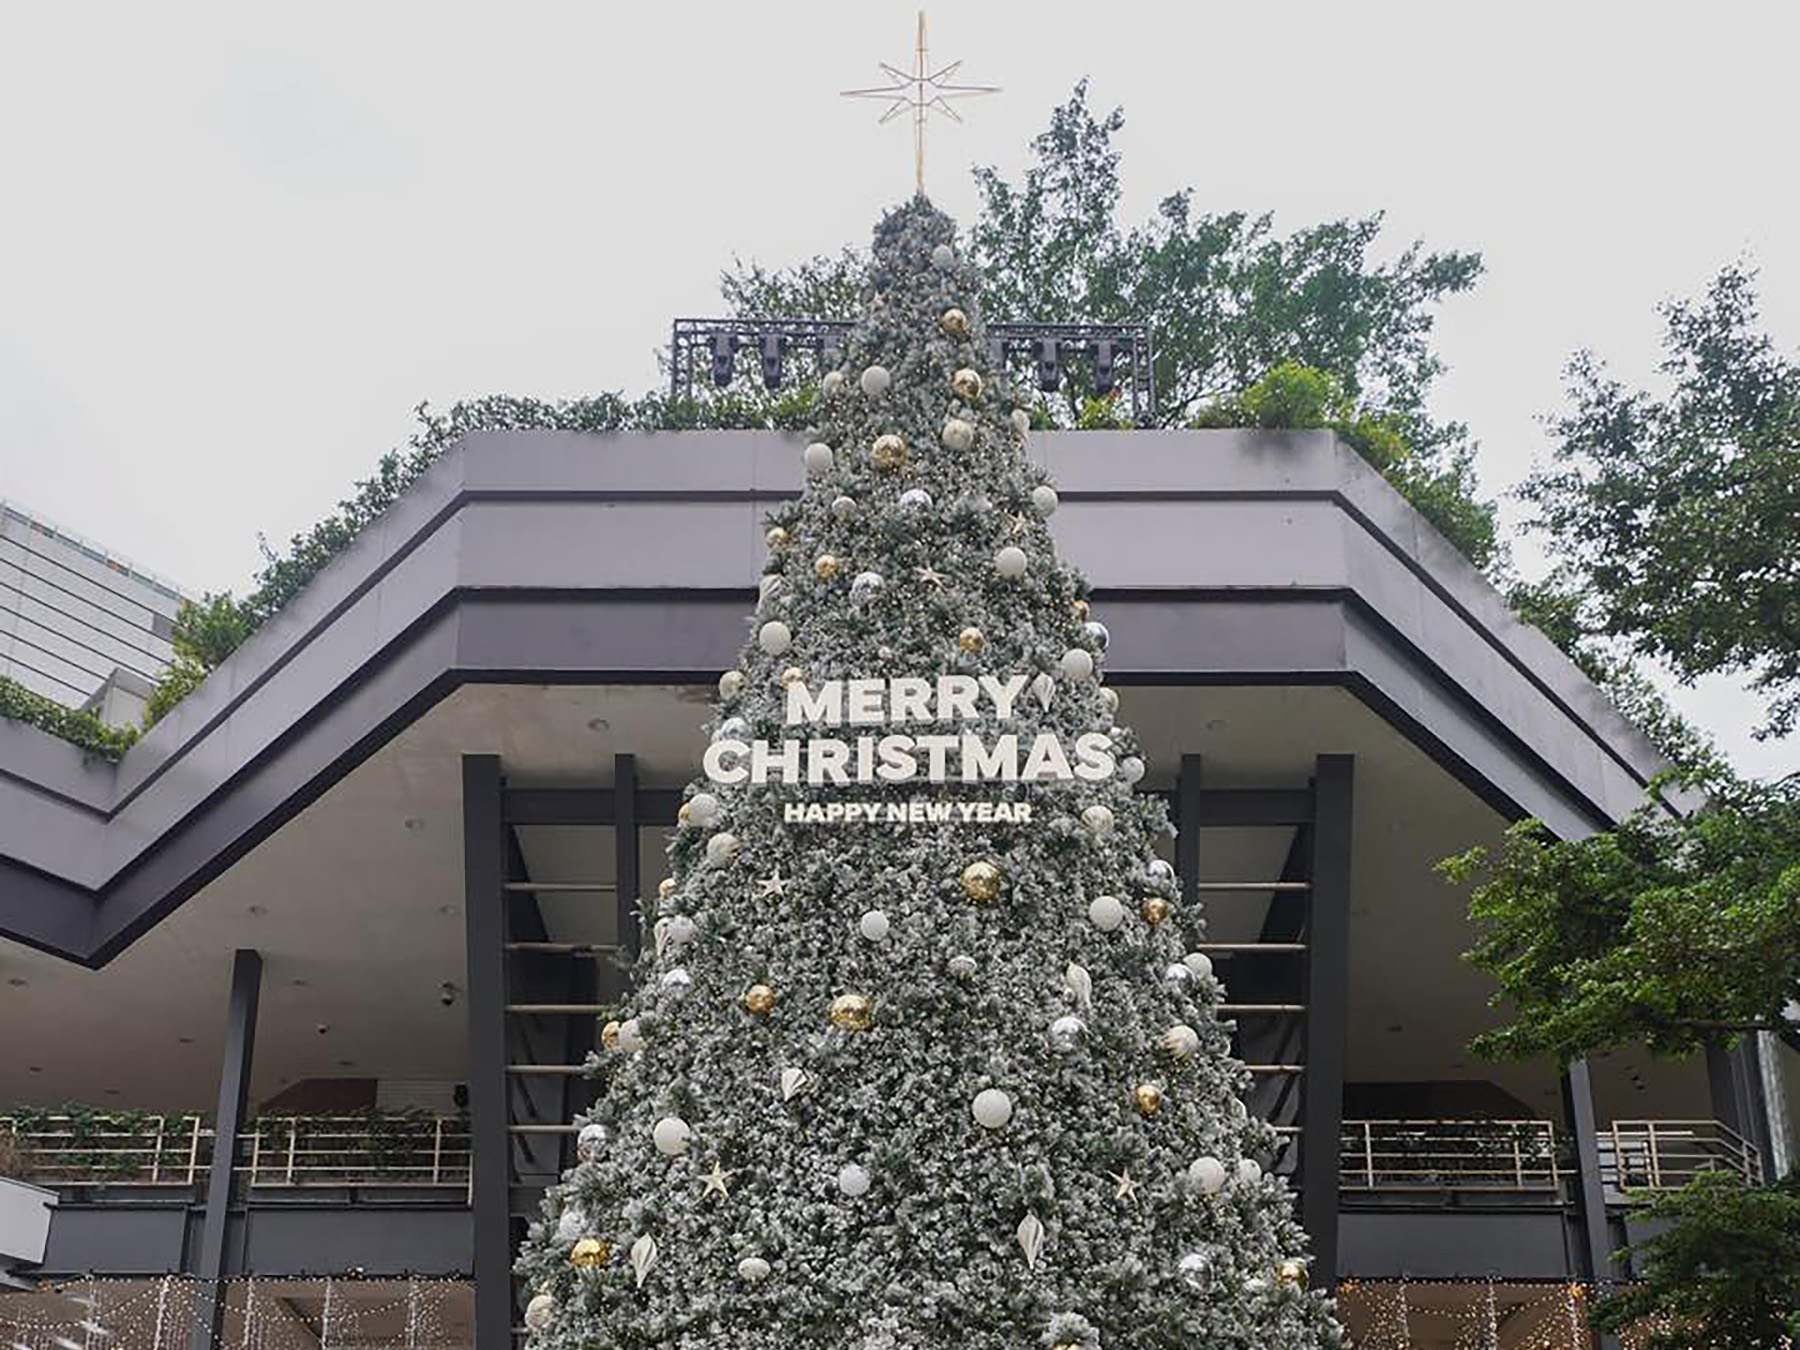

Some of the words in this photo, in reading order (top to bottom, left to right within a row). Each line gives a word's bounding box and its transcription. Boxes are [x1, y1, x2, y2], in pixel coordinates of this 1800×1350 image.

[786, 674, 1028, 727] MERRY
[702, 733, 1116, 786] CHRISTMAS
[783, 802, 881, 823] HAPPY
[886, 802, 952, 823] NEW
[956, 801, 1032, 822] YEAR
